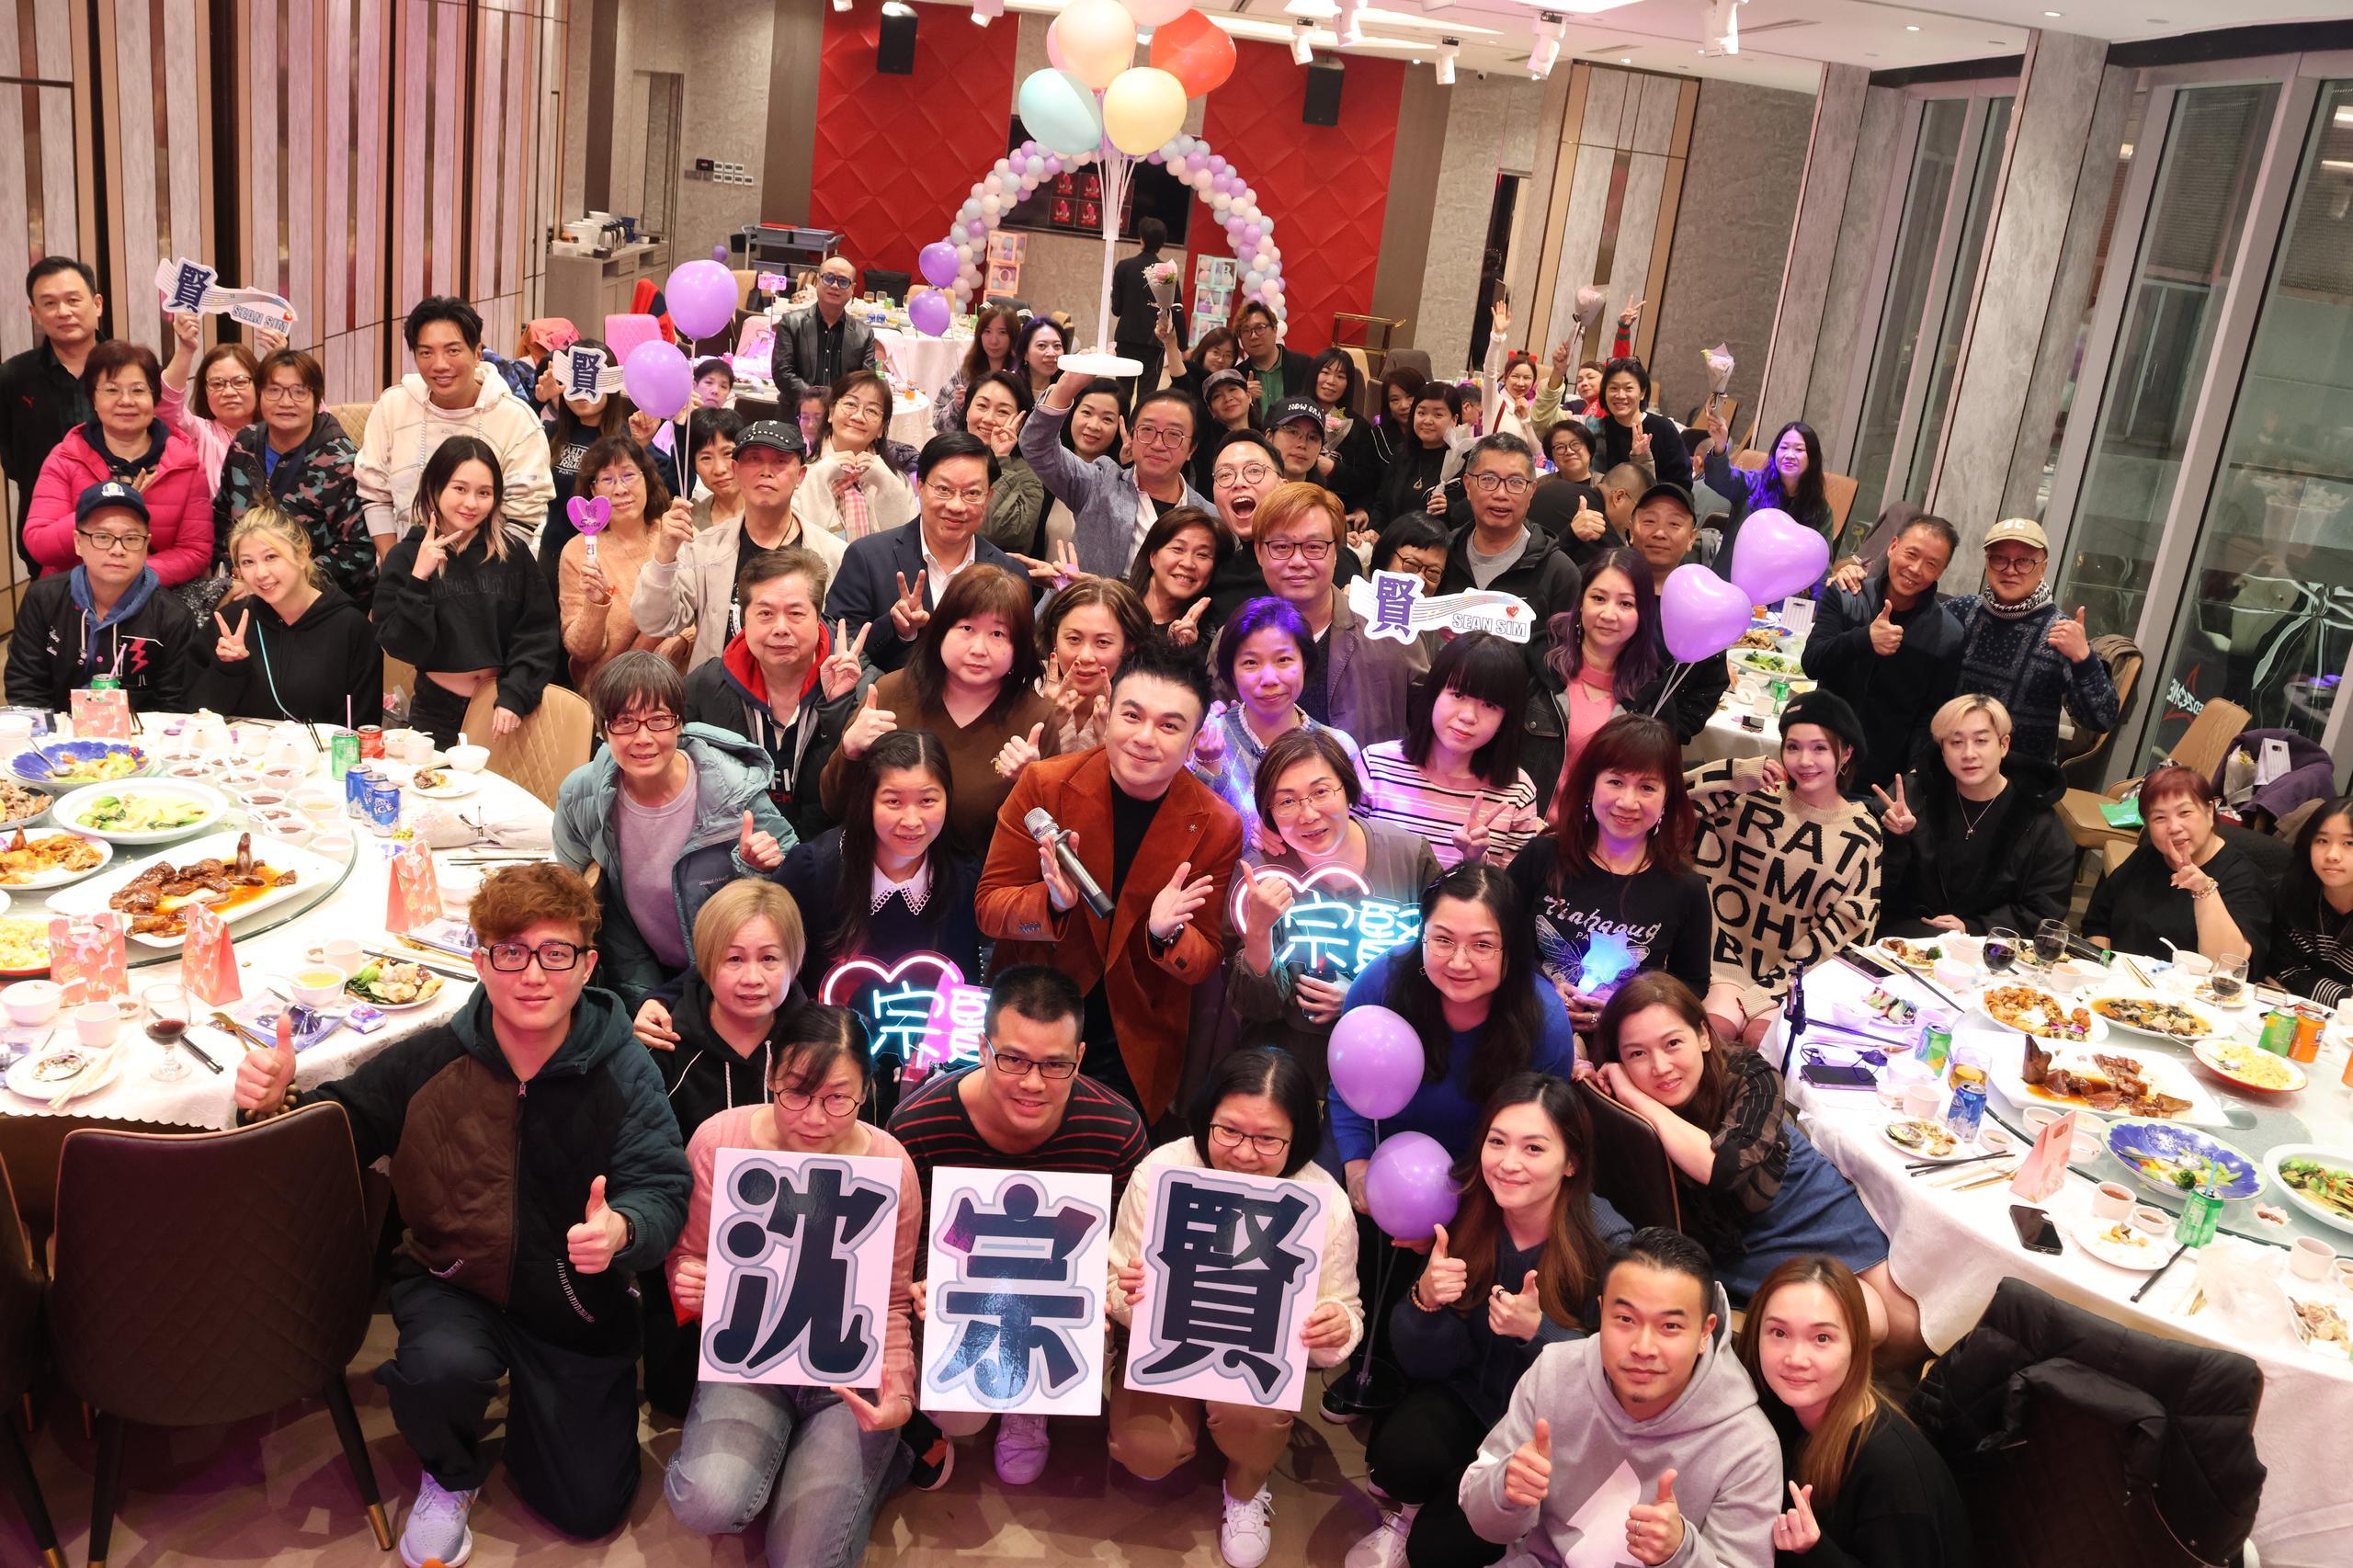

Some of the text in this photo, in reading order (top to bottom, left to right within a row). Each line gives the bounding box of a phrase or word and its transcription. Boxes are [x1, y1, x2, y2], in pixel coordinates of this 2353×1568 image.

[168, 263, 212, 313] 賢
[232, 304, 289, 334] SEAN SIM
[569, 350, 600, 399] 賢
[1372, 575, 1417, 638] 賢
[1452, 613, 1528, 637] SEAN SIM
[713, 1167, 1306, 1401] 沈 宗 賢
